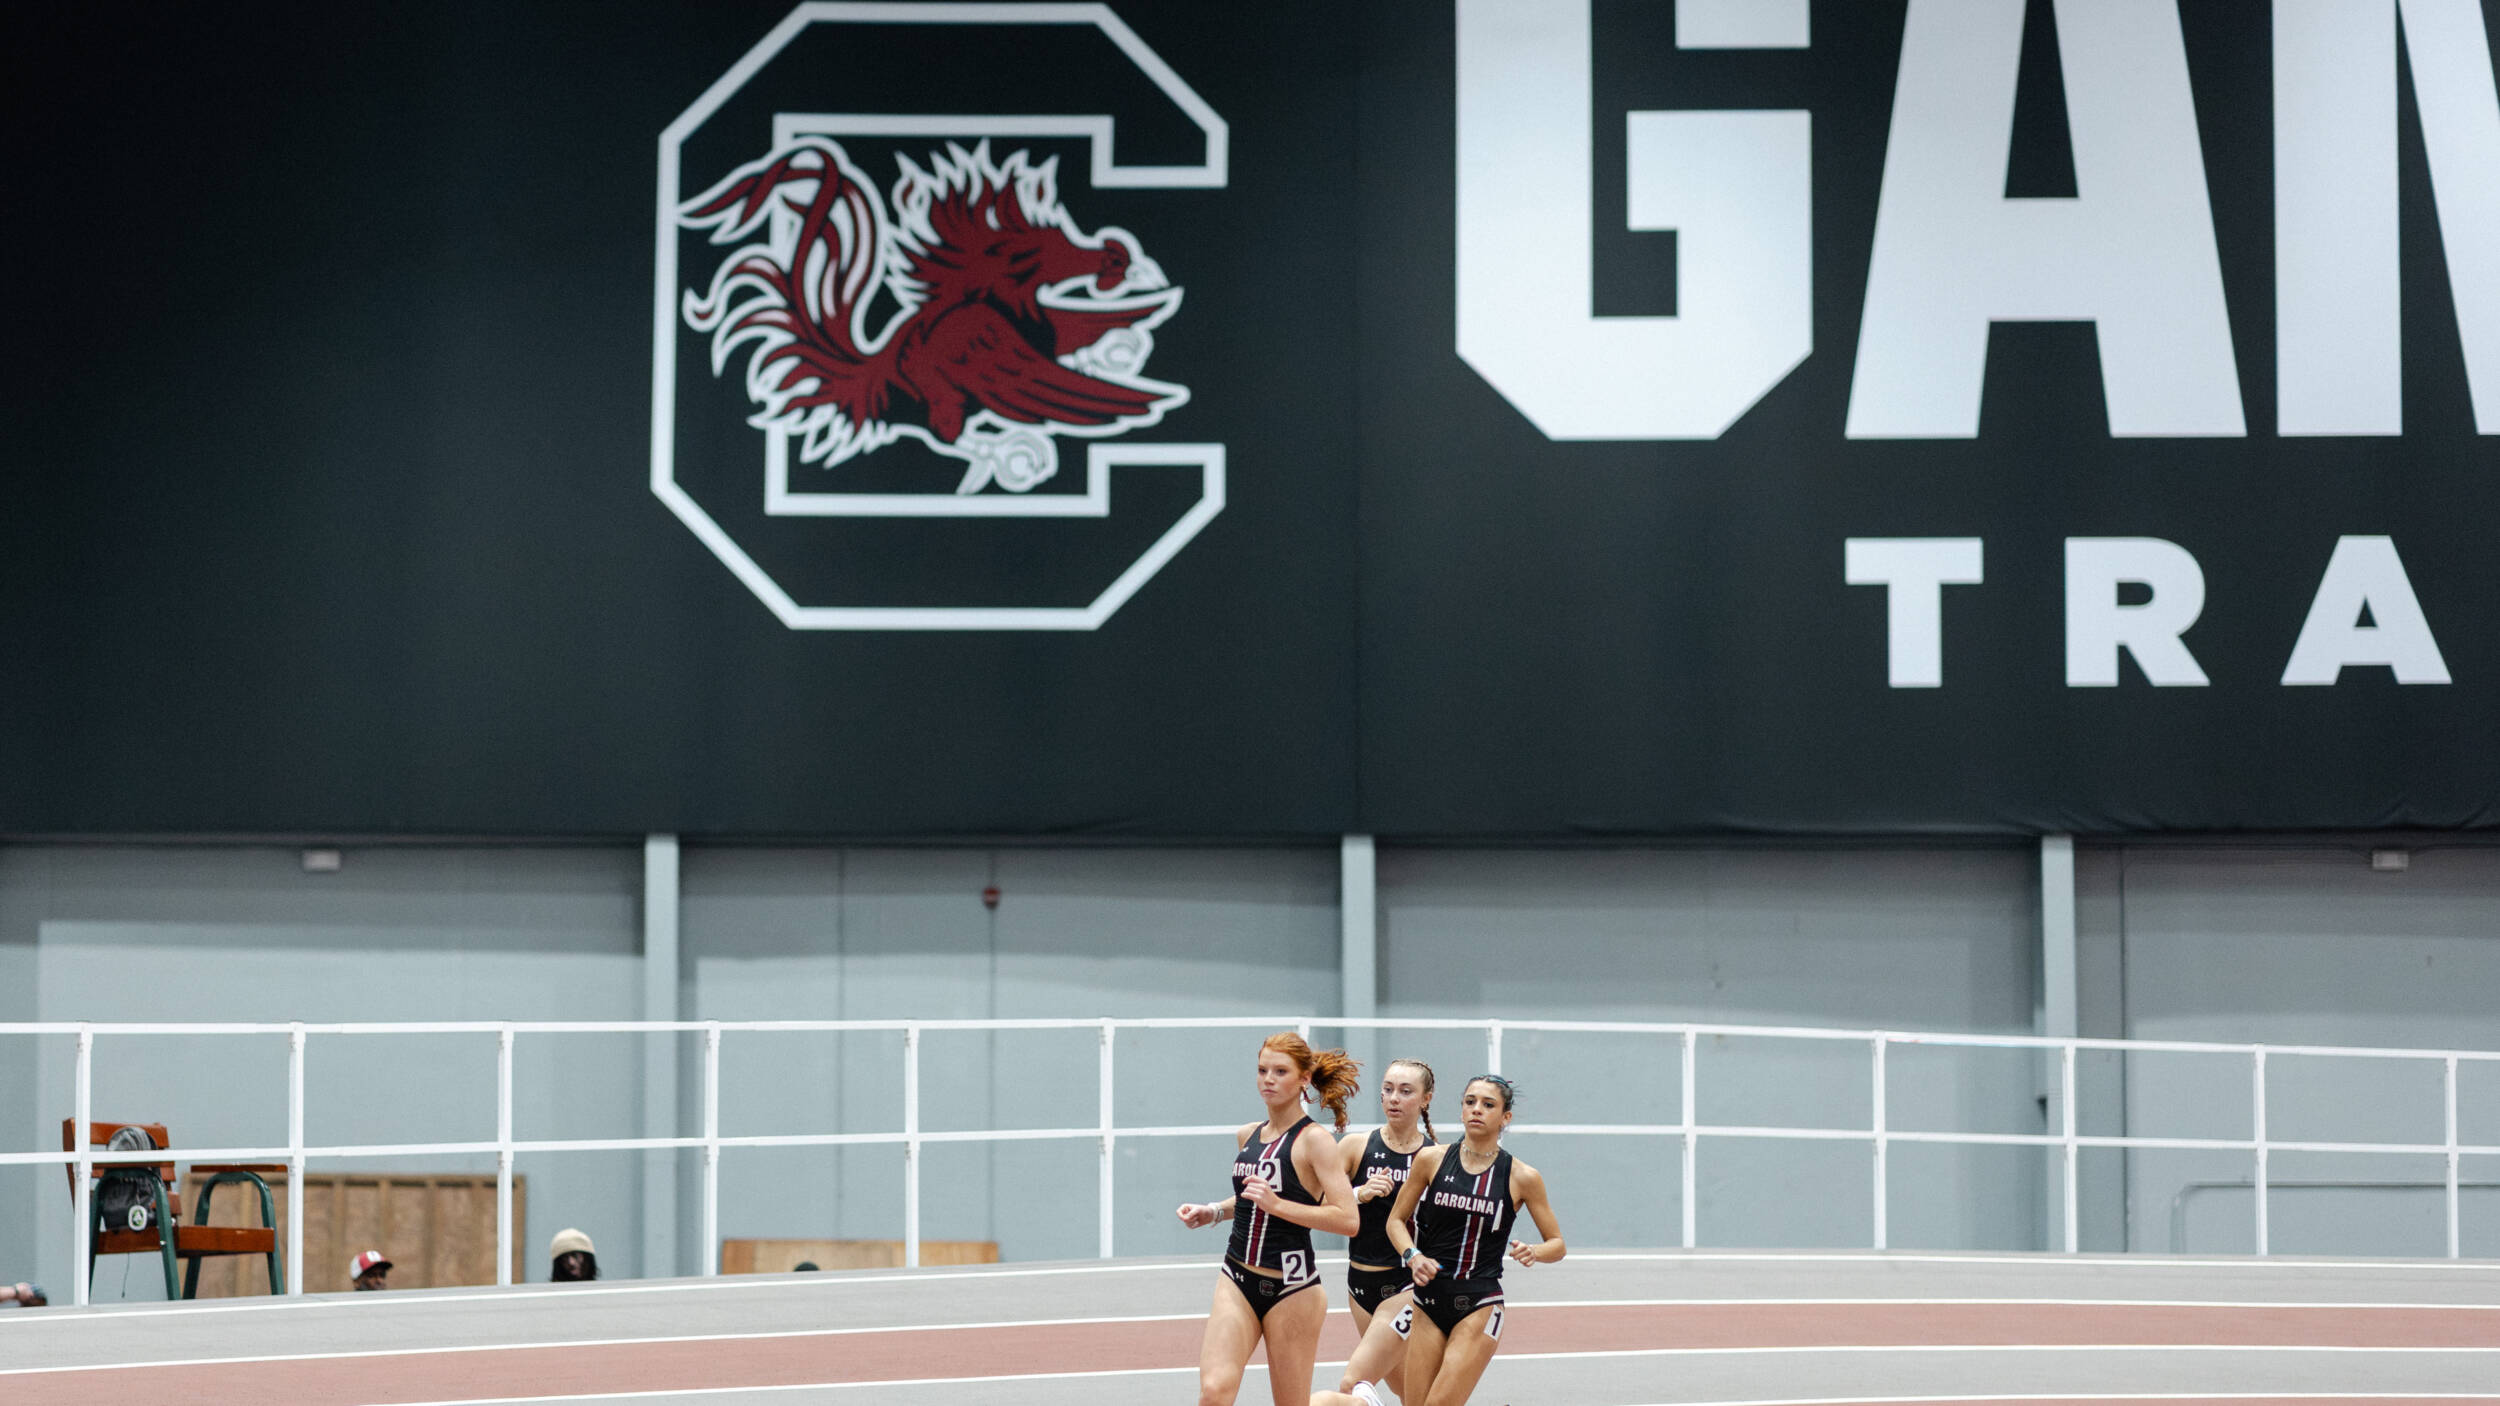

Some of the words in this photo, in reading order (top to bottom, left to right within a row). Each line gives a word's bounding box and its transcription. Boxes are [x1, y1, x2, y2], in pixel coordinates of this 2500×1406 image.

[1845, 536, 2452, 688] TRA
[1261, 1161, 1277, 1190] 2
[1434, 1191, 1495, 1215] CAROLINA
[1285, 1253, 1304, 1282] 2
[1395, 1309, 1413, 1334] 3
[1491, 1311, 1502, 1337] 1
